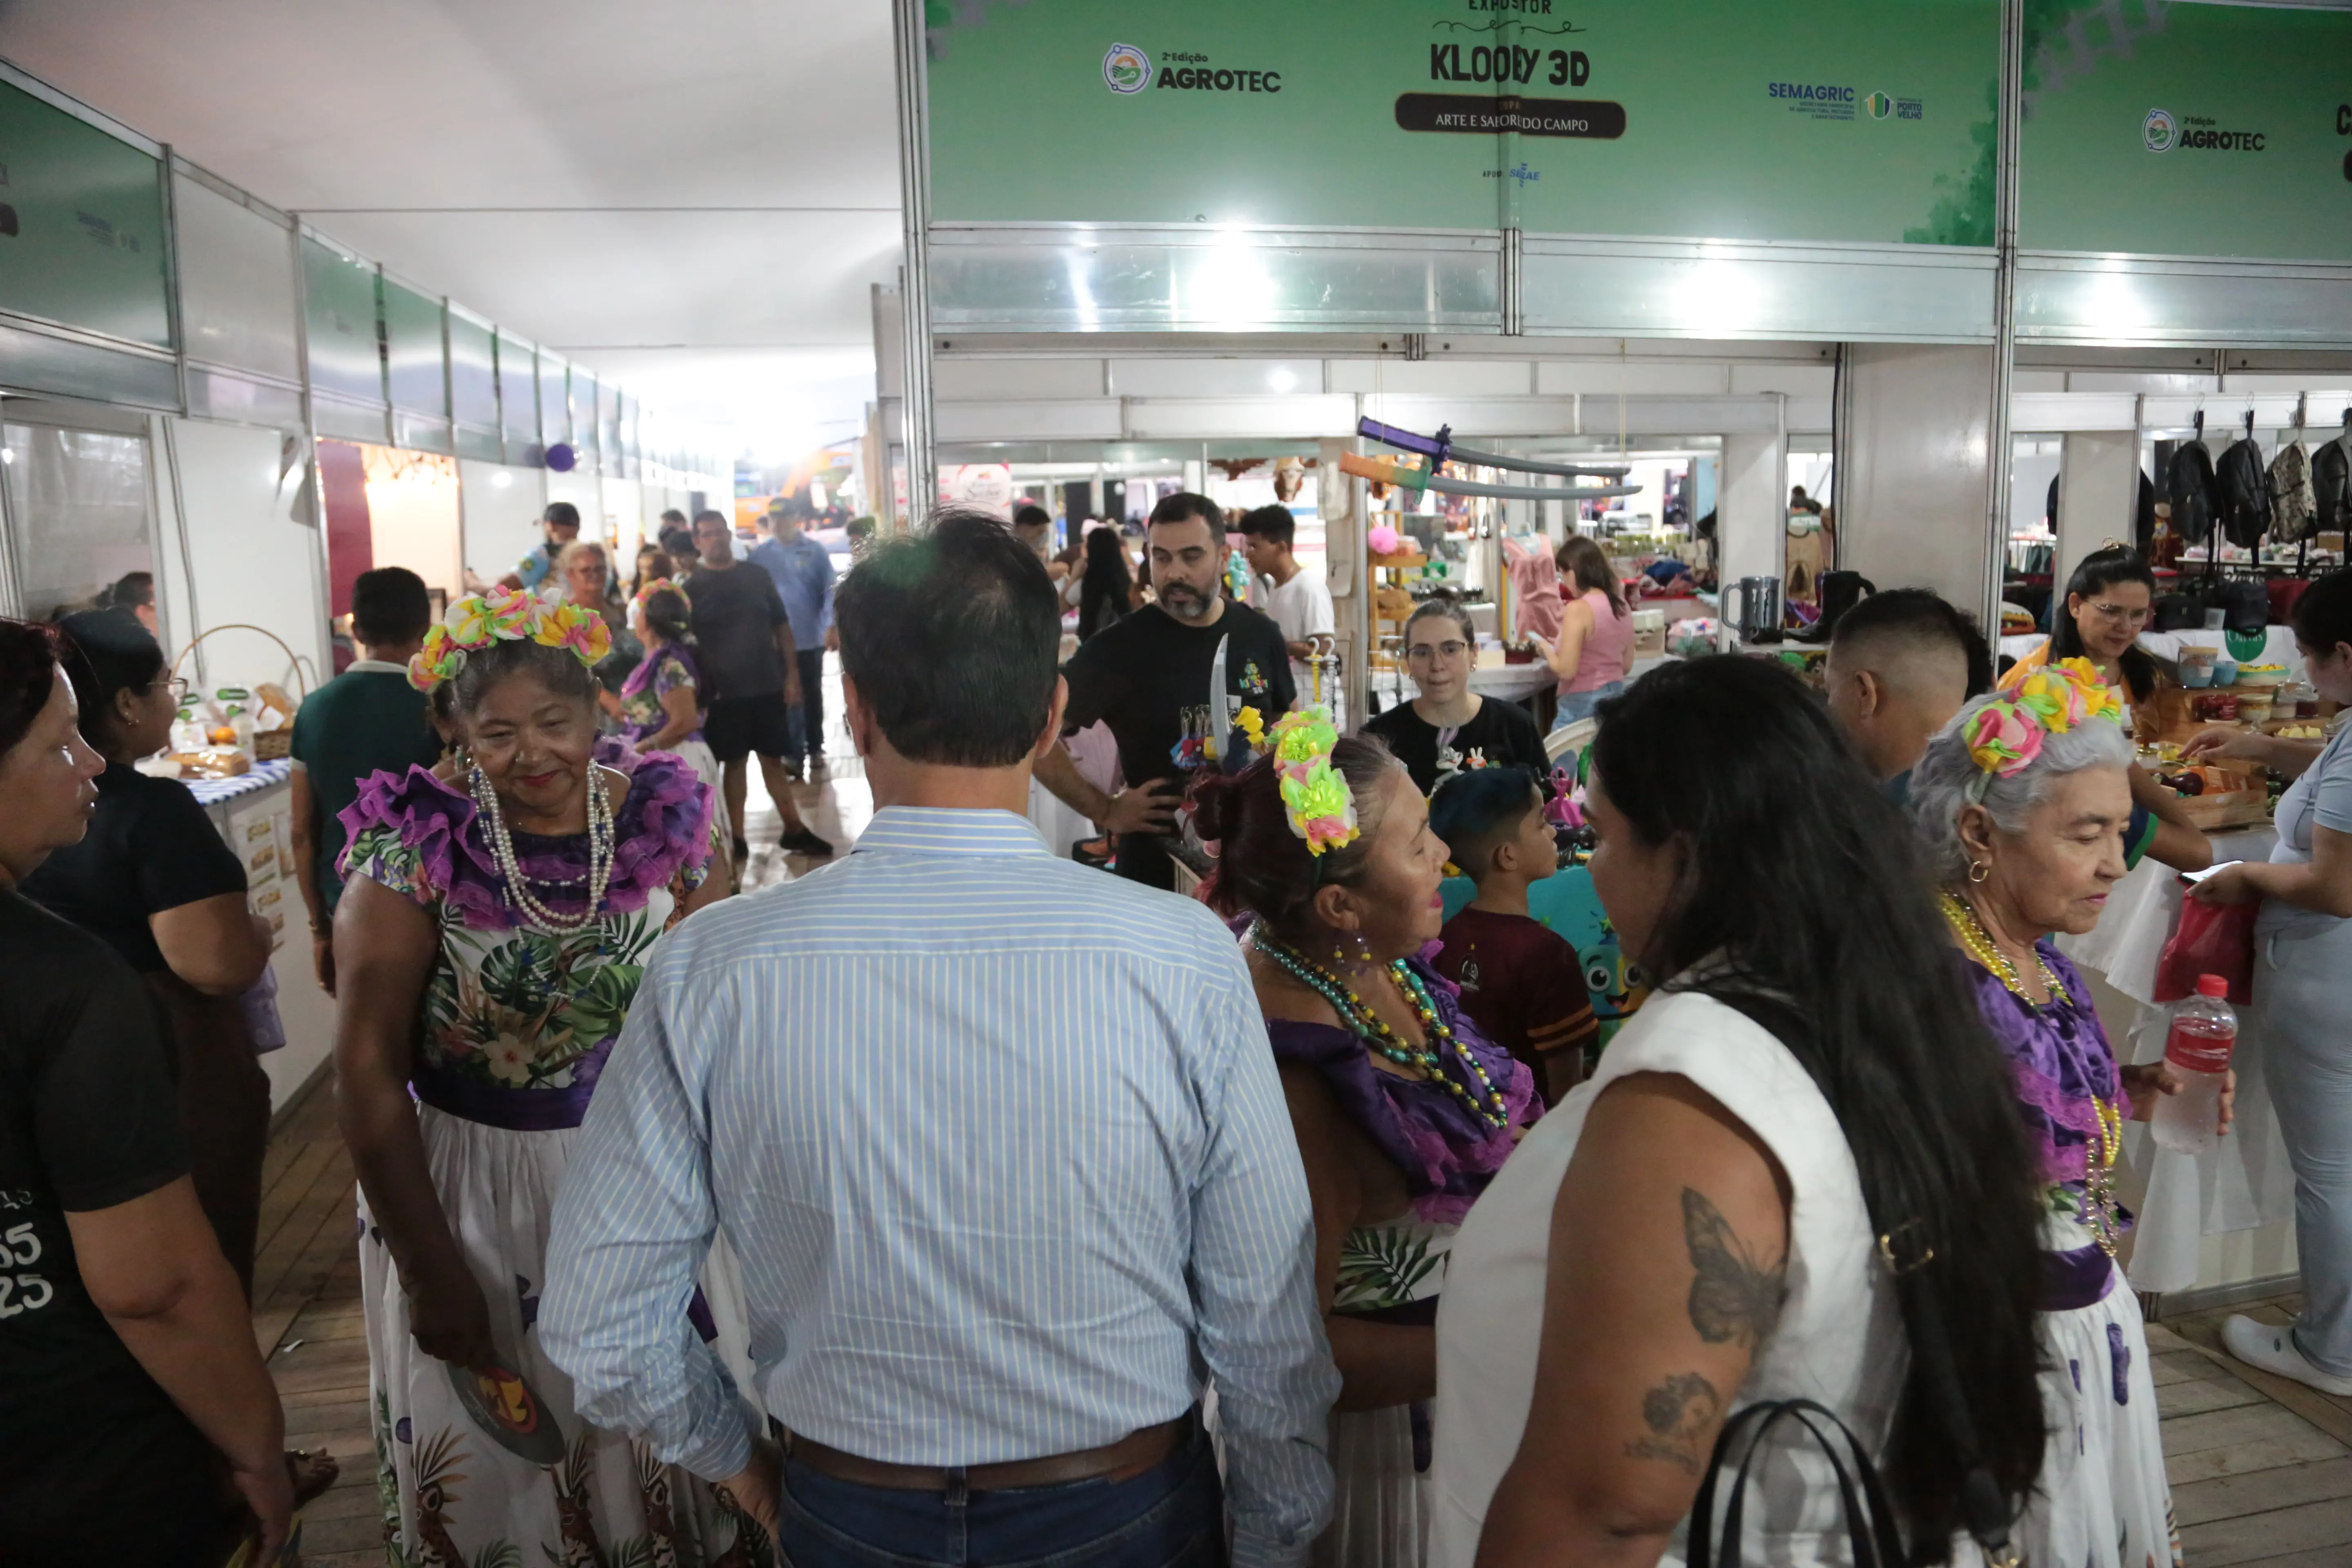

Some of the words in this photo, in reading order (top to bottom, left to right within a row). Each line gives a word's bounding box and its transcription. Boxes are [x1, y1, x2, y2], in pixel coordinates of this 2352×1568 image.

[1172, 52, 1208, 65] Edição
[1548, 49, 1590, 87] 3D
[1157, 67, 1281, 93] AGROTEC
[1769, 82, 1854, 102] SEMAGRIC
[1897, 102, 1922, 111] PORTO
[1436, 114, 1467, 127] ARTE
[1470, 115, 1477, 126] E
[1523, 118, 1541, 130] DO
[1544, 118, 1588, 131] CAMPO
[1898, 111, 1922, 120] VELHO
[2190, 117, 2216, 127] Edição
[2179, 129, 2266, 151] AGROTEC
